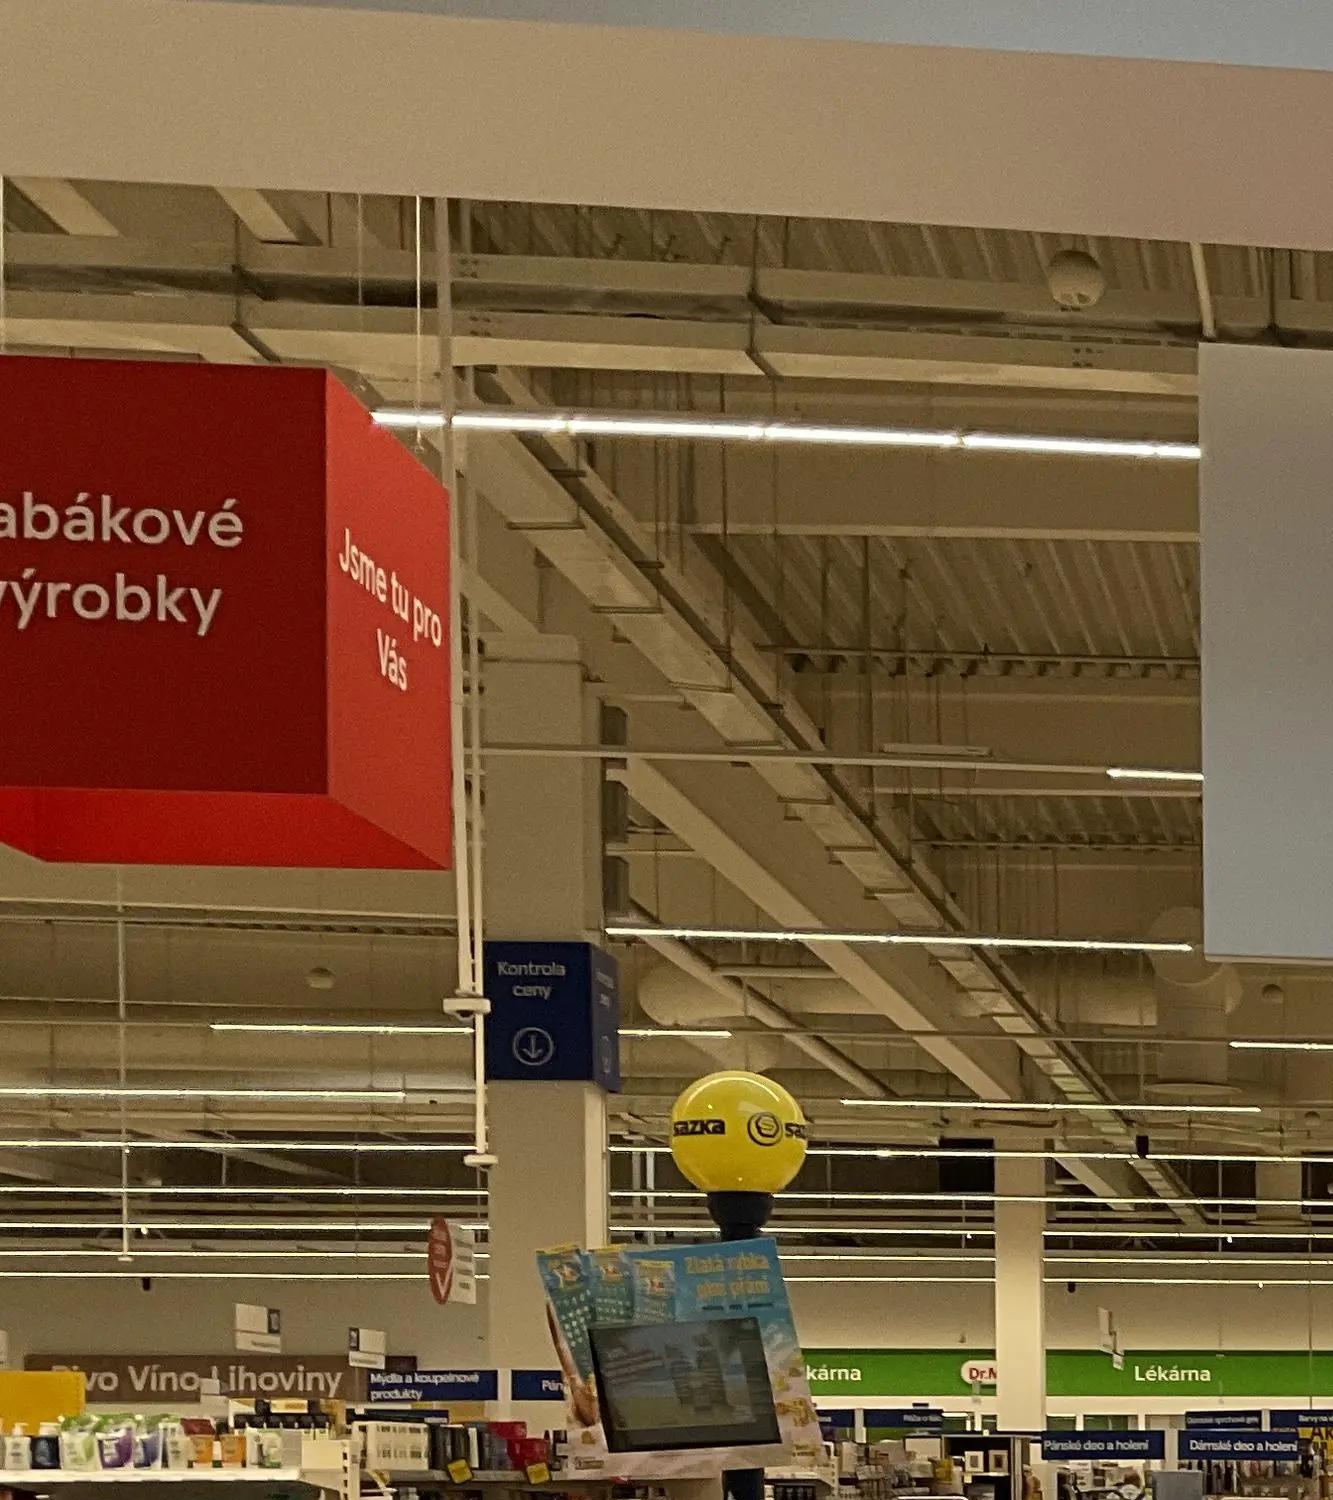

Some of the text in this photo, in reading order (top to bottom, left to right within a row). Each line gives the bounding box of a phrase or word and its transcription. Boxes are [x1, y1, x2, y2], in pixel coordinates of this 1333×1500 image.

[0, 491, 244, 547] abákové
[339, 528, 442, 647] Jsme tu pro
[0, 568, 222, 636] ýrobky
[376, 628, 408, 692] Vás
[497, 961, 567, 977] Kontrola
[513, 983, 552, 1000] ceny
[128, 1363, 201, 1392] Víno
[806, 1364, 862, 1382] kárna
[1134, 1365, 1212, 1383] Lékárna
[371, 1388, 423, 1401] produkty
[1044, 1439, 1150, 1451] Pánské deo a holení
[1189, 1438, 1298, 1451] Dámské deo a holení
